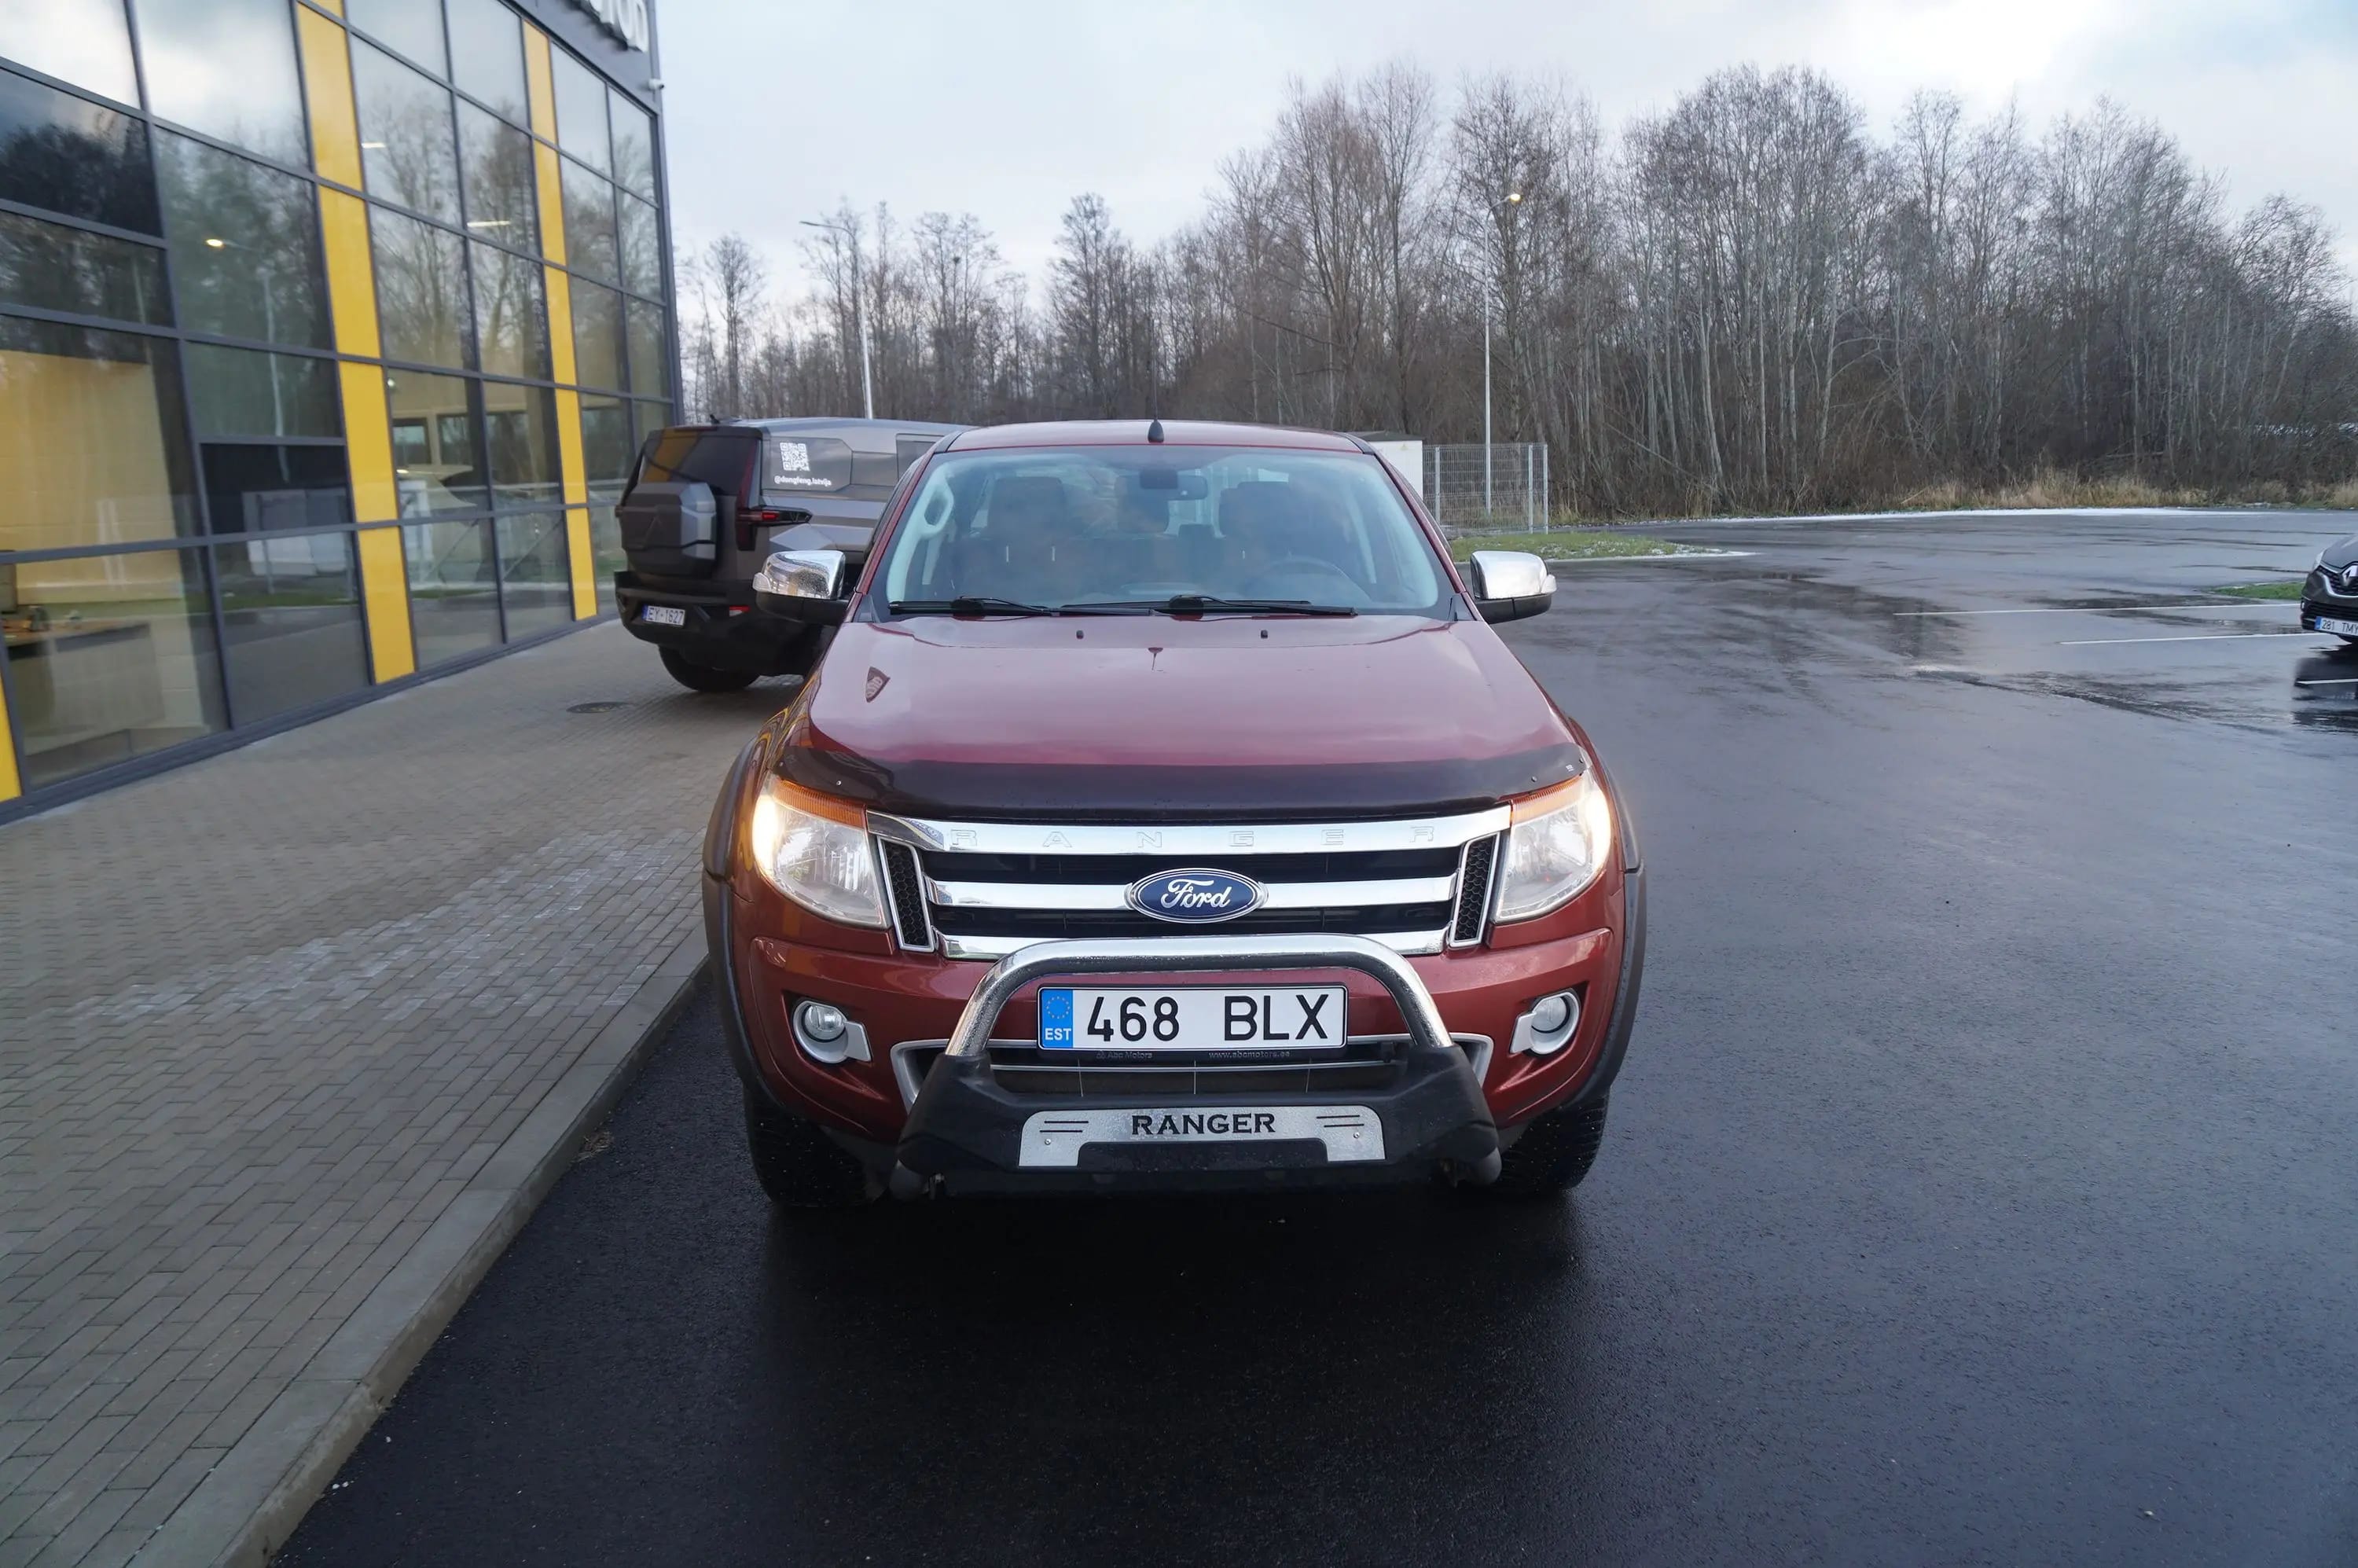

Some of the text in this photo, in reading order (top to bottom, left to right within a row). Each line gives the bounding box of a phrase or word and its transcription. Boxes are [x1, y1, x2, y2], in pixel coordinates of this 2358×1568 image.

[774, 476, 832, 487] @dongfeng.latvija
[648, 607, 684, 624] EY-1627
[2322, 619, 2334, 630] 281
[949, 825, 1434, 848] RANGER
[1161, 878, 1231, 909] Ford
[1087, 993, 1329, 1041] 468 BLX
[1045, 1027, 1071, 1041] EST
[1126, 1051, 1152, 1059] Motors
[1209, 1050, 1290, 1059] www.abcmotors.ee
[1132, 1113, 1276, 1135] RANGER
